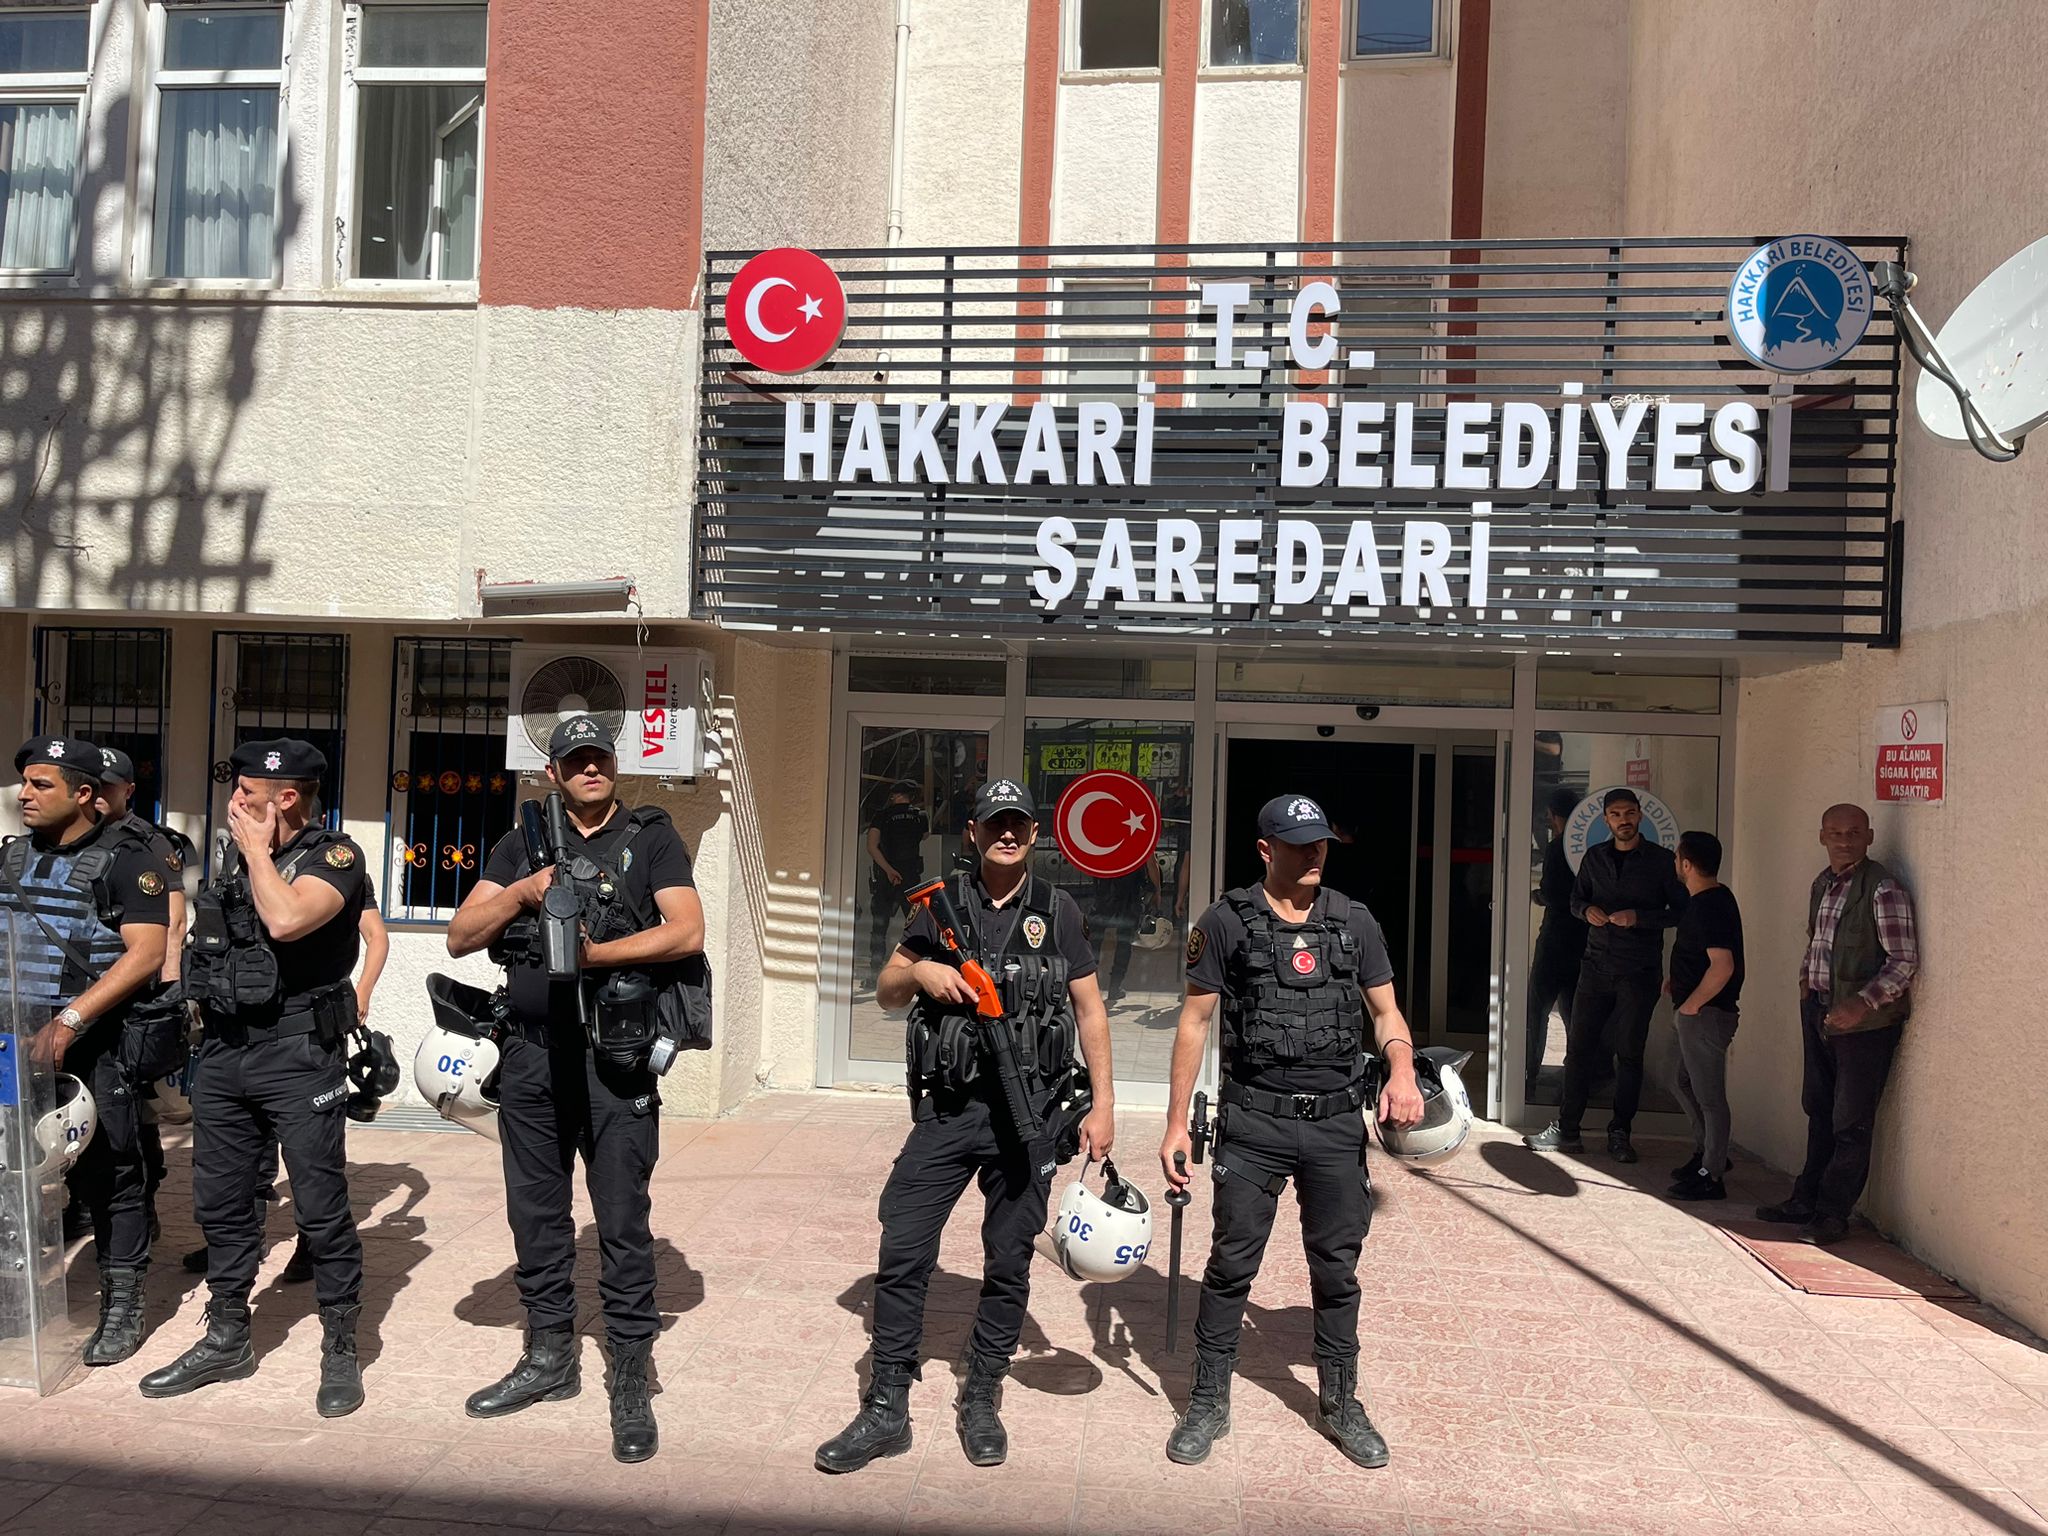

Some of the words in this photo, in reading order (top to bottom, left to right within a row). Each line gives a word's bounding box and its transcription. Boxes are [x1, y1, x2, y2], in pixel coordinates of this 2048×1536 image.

[1737, 243, 1786, 323] HAKKARİ
[1790, 241, 1866, 313] BELEDİYESİ
[783, 382, 1157, 487] HAKKARİ
[1280, 381, 1794, 493] BELEDİYESİ
[1033, 501, 1492, 610] ŞAREDARİ
[642, 663, 668, 758] VESTEL
[1885, 749, 1897, 762] BU
[1898, 749, 1931, 762] ALANDA
[1879, 764, 1909, 779] SİGARA
[1910, 764, 1938, 782] İÇMEK
[1889, 784, 1930, 798] YASAKTIR
[438, 1055, 466, 1077] 30
[66, 1120, 90, 1143] 30
[1068, 1214, 1094, 1242] 30
